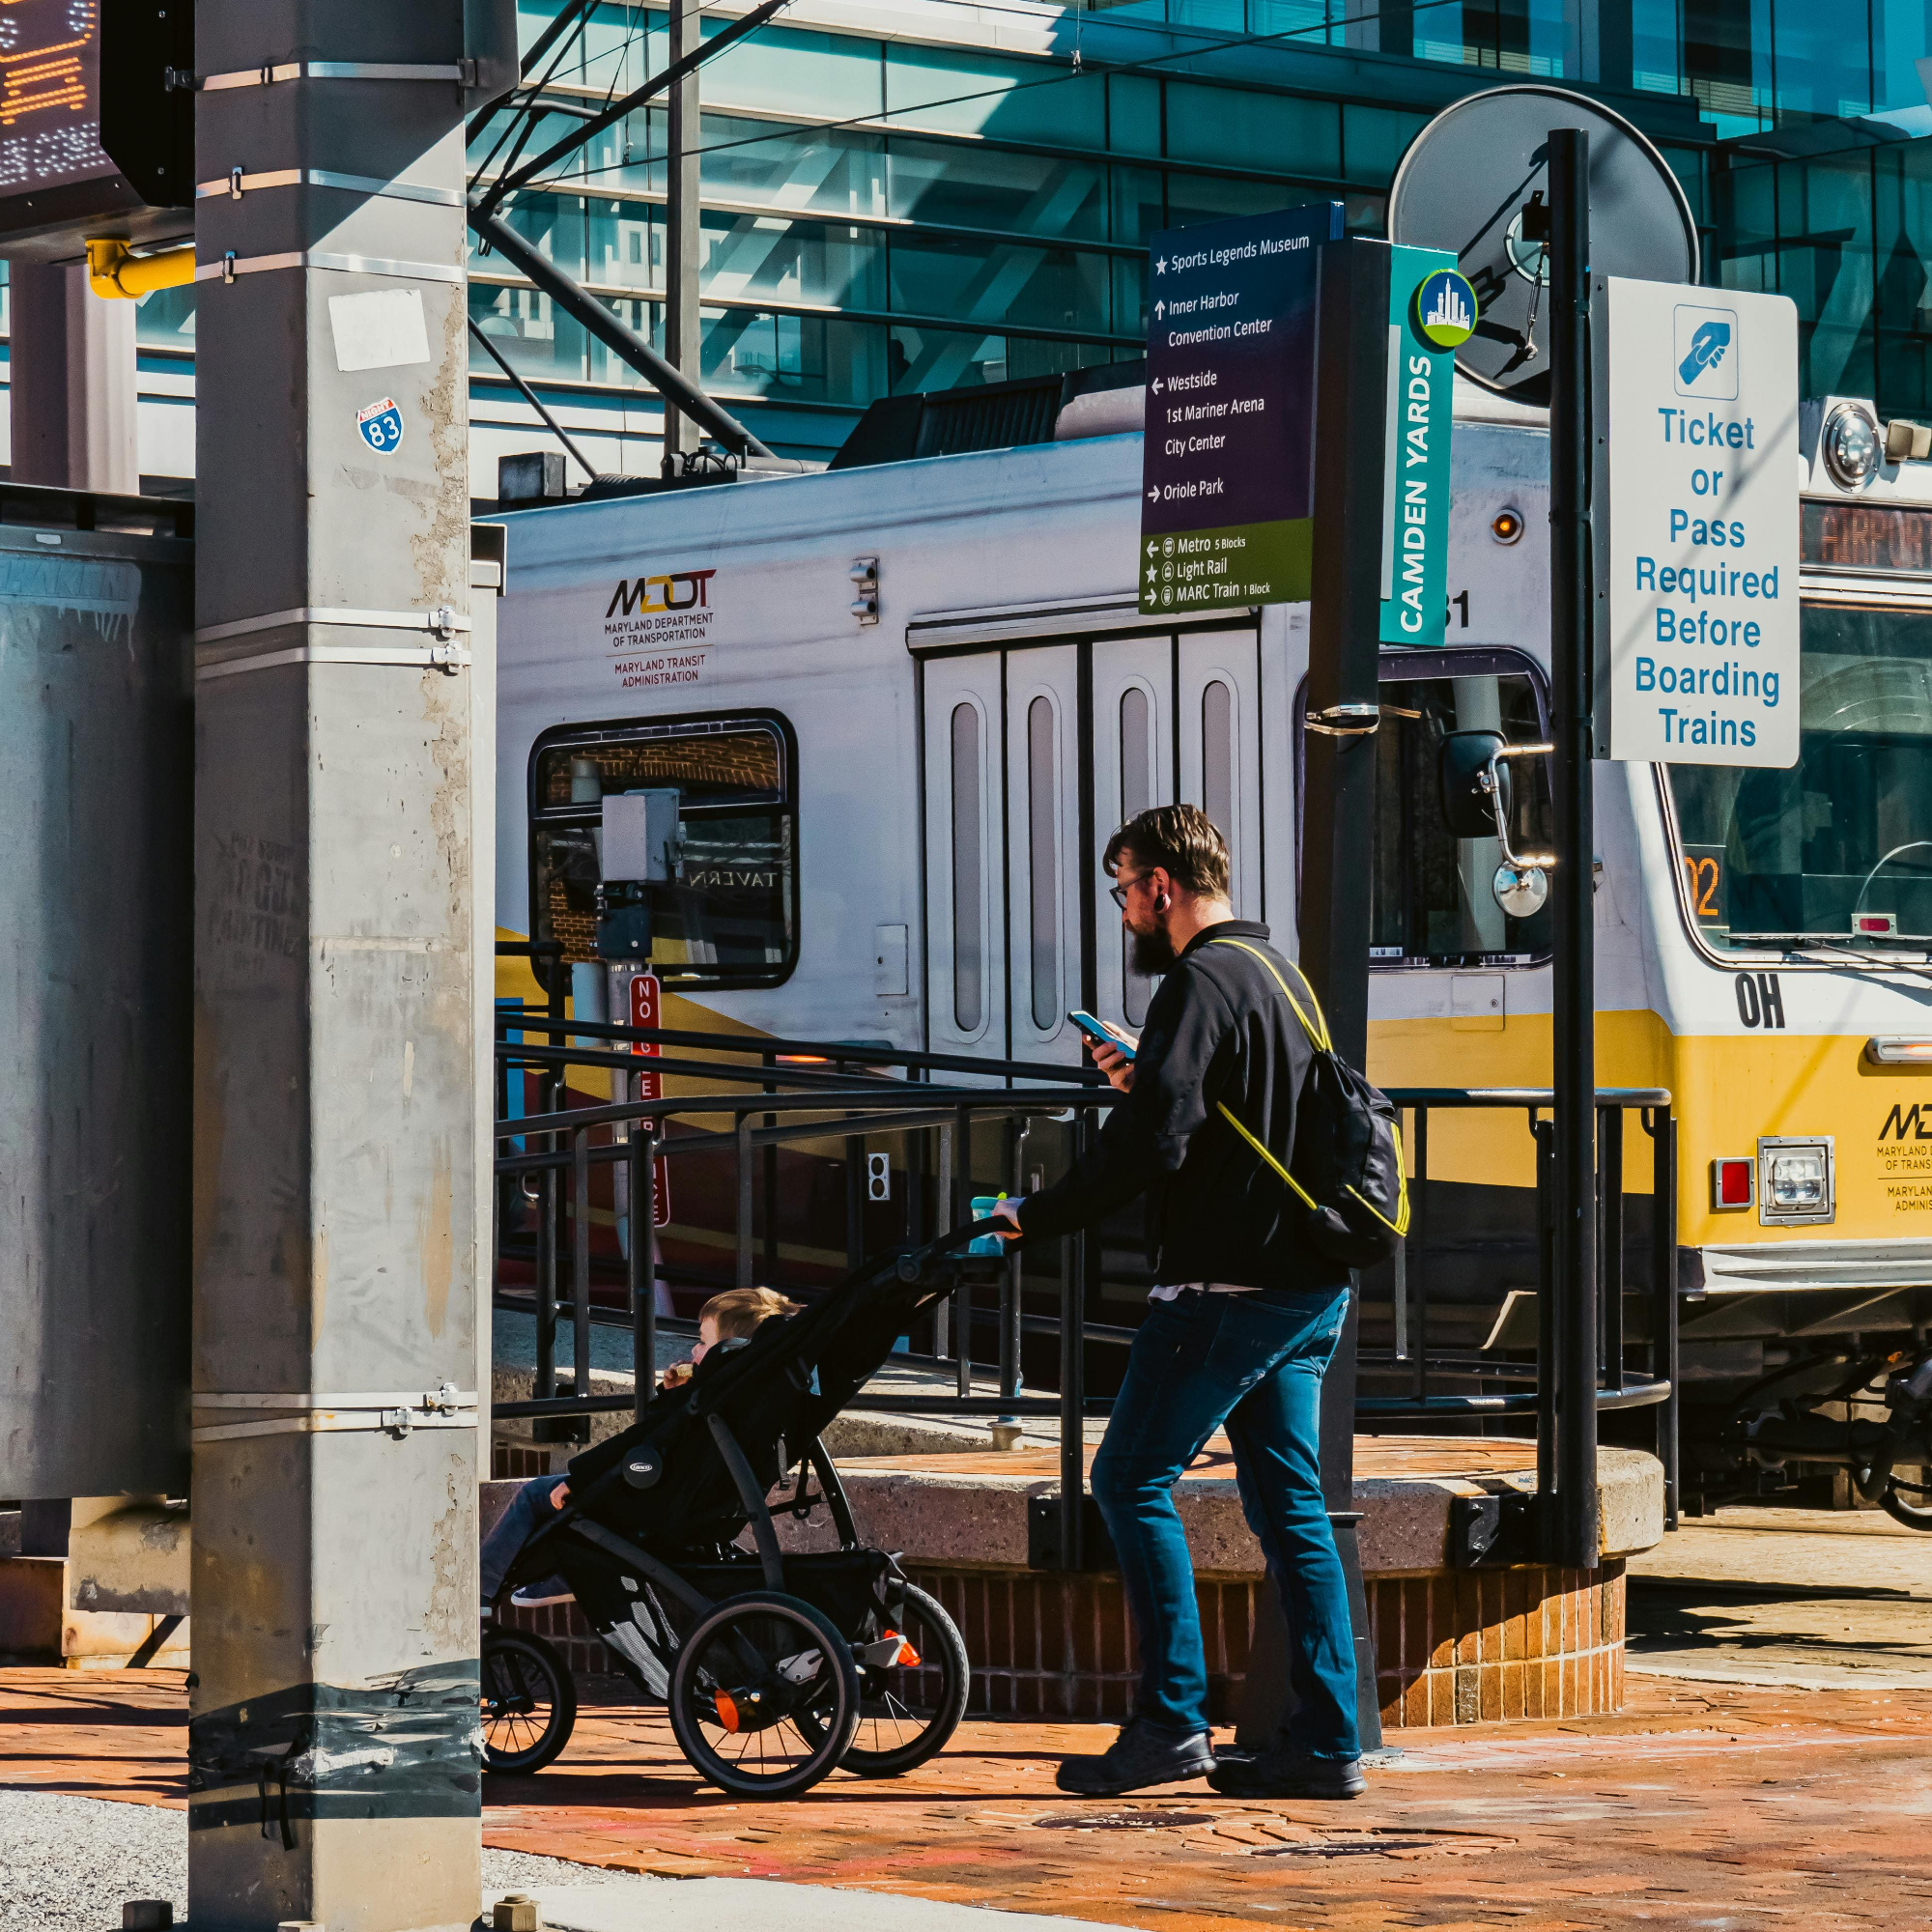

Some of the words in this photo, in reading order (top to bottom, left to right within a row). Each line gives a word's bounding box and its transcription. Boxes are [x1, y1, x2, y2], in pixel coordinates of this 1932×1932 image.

[1171, 252, 1208, 273] Sports
[1209, 242, 1257, 267] Legends
[1260, 236, 1310, 256] Museum
[1169, 298, 1198, 316] Inner
[1200, 291, 1239, 310] Harbor
[1168, 325, 1231, 347] Convention
[1234, 318, 1272, 337] Center
[1167, 370, 1217, 392] Westside
[1166, 407, 1182, 423] 1st
[1184, 401, 1229, 421] Mariner
[1231, 398, 1264, 415] Arena
[1406, 355, 1432, 469] YARDS
[368, 416, 400, 447] 83
[1658, 408, 1755, 450] Ticket
[1165, 438, 1186, 458] City
[1188, 434, 1226, 452] Center
[1163, 481, 1197, 500] Oriole
[1199, 477, 1224, 496] Park
[1690, 469, 1723, 497] or
[1670, 508, 1746, 549] Pass
[1178, 538, 1211, 554] Metro
[1214, 541, 1220, 551] 5
[1221, 536, 1246, 549] Blocks
[1400, 480, 1428, 633] CAMDEN
[1177, 560, 1205, 582] Light
[1207, 557, 1228, 575] Rail
[1635, 556, 1778, 604] Required
[1177, 584, 1210, 602] MARC
[1213, 582, 1239, 598] Train
[1243, 585, 1247, 595] 1
[1249, 582, 1270, 595] Block
[1445, 589, 1469, 628] 1
[605, 618, 653, 635] MARYLAND
[655, 612, 714, 630] DEPARTMENT
[612, 636, 625, 647] OF
[628, 627, 705, 646] TRANSPORTATION
[1656, 608, 1761, 647] Before
[614, 658, 665, 674] MARYLAND
[667, 654, 706, 668] TRANSIT
[622, 669, 698, 688] ADMINISTRATION
[1635, 656, 1779, 708] Boarding
[1658, 707, 1756, 747] Trains
[639, 980, 651, 1019] NO
[1735, 973, 1786, 1029] OH
[1876, 1145, 1927, 1157] MARYLAND
[1885, 1159, 1898, 1171] OF
[1901, 1158, 1932, 1171] TRANS
